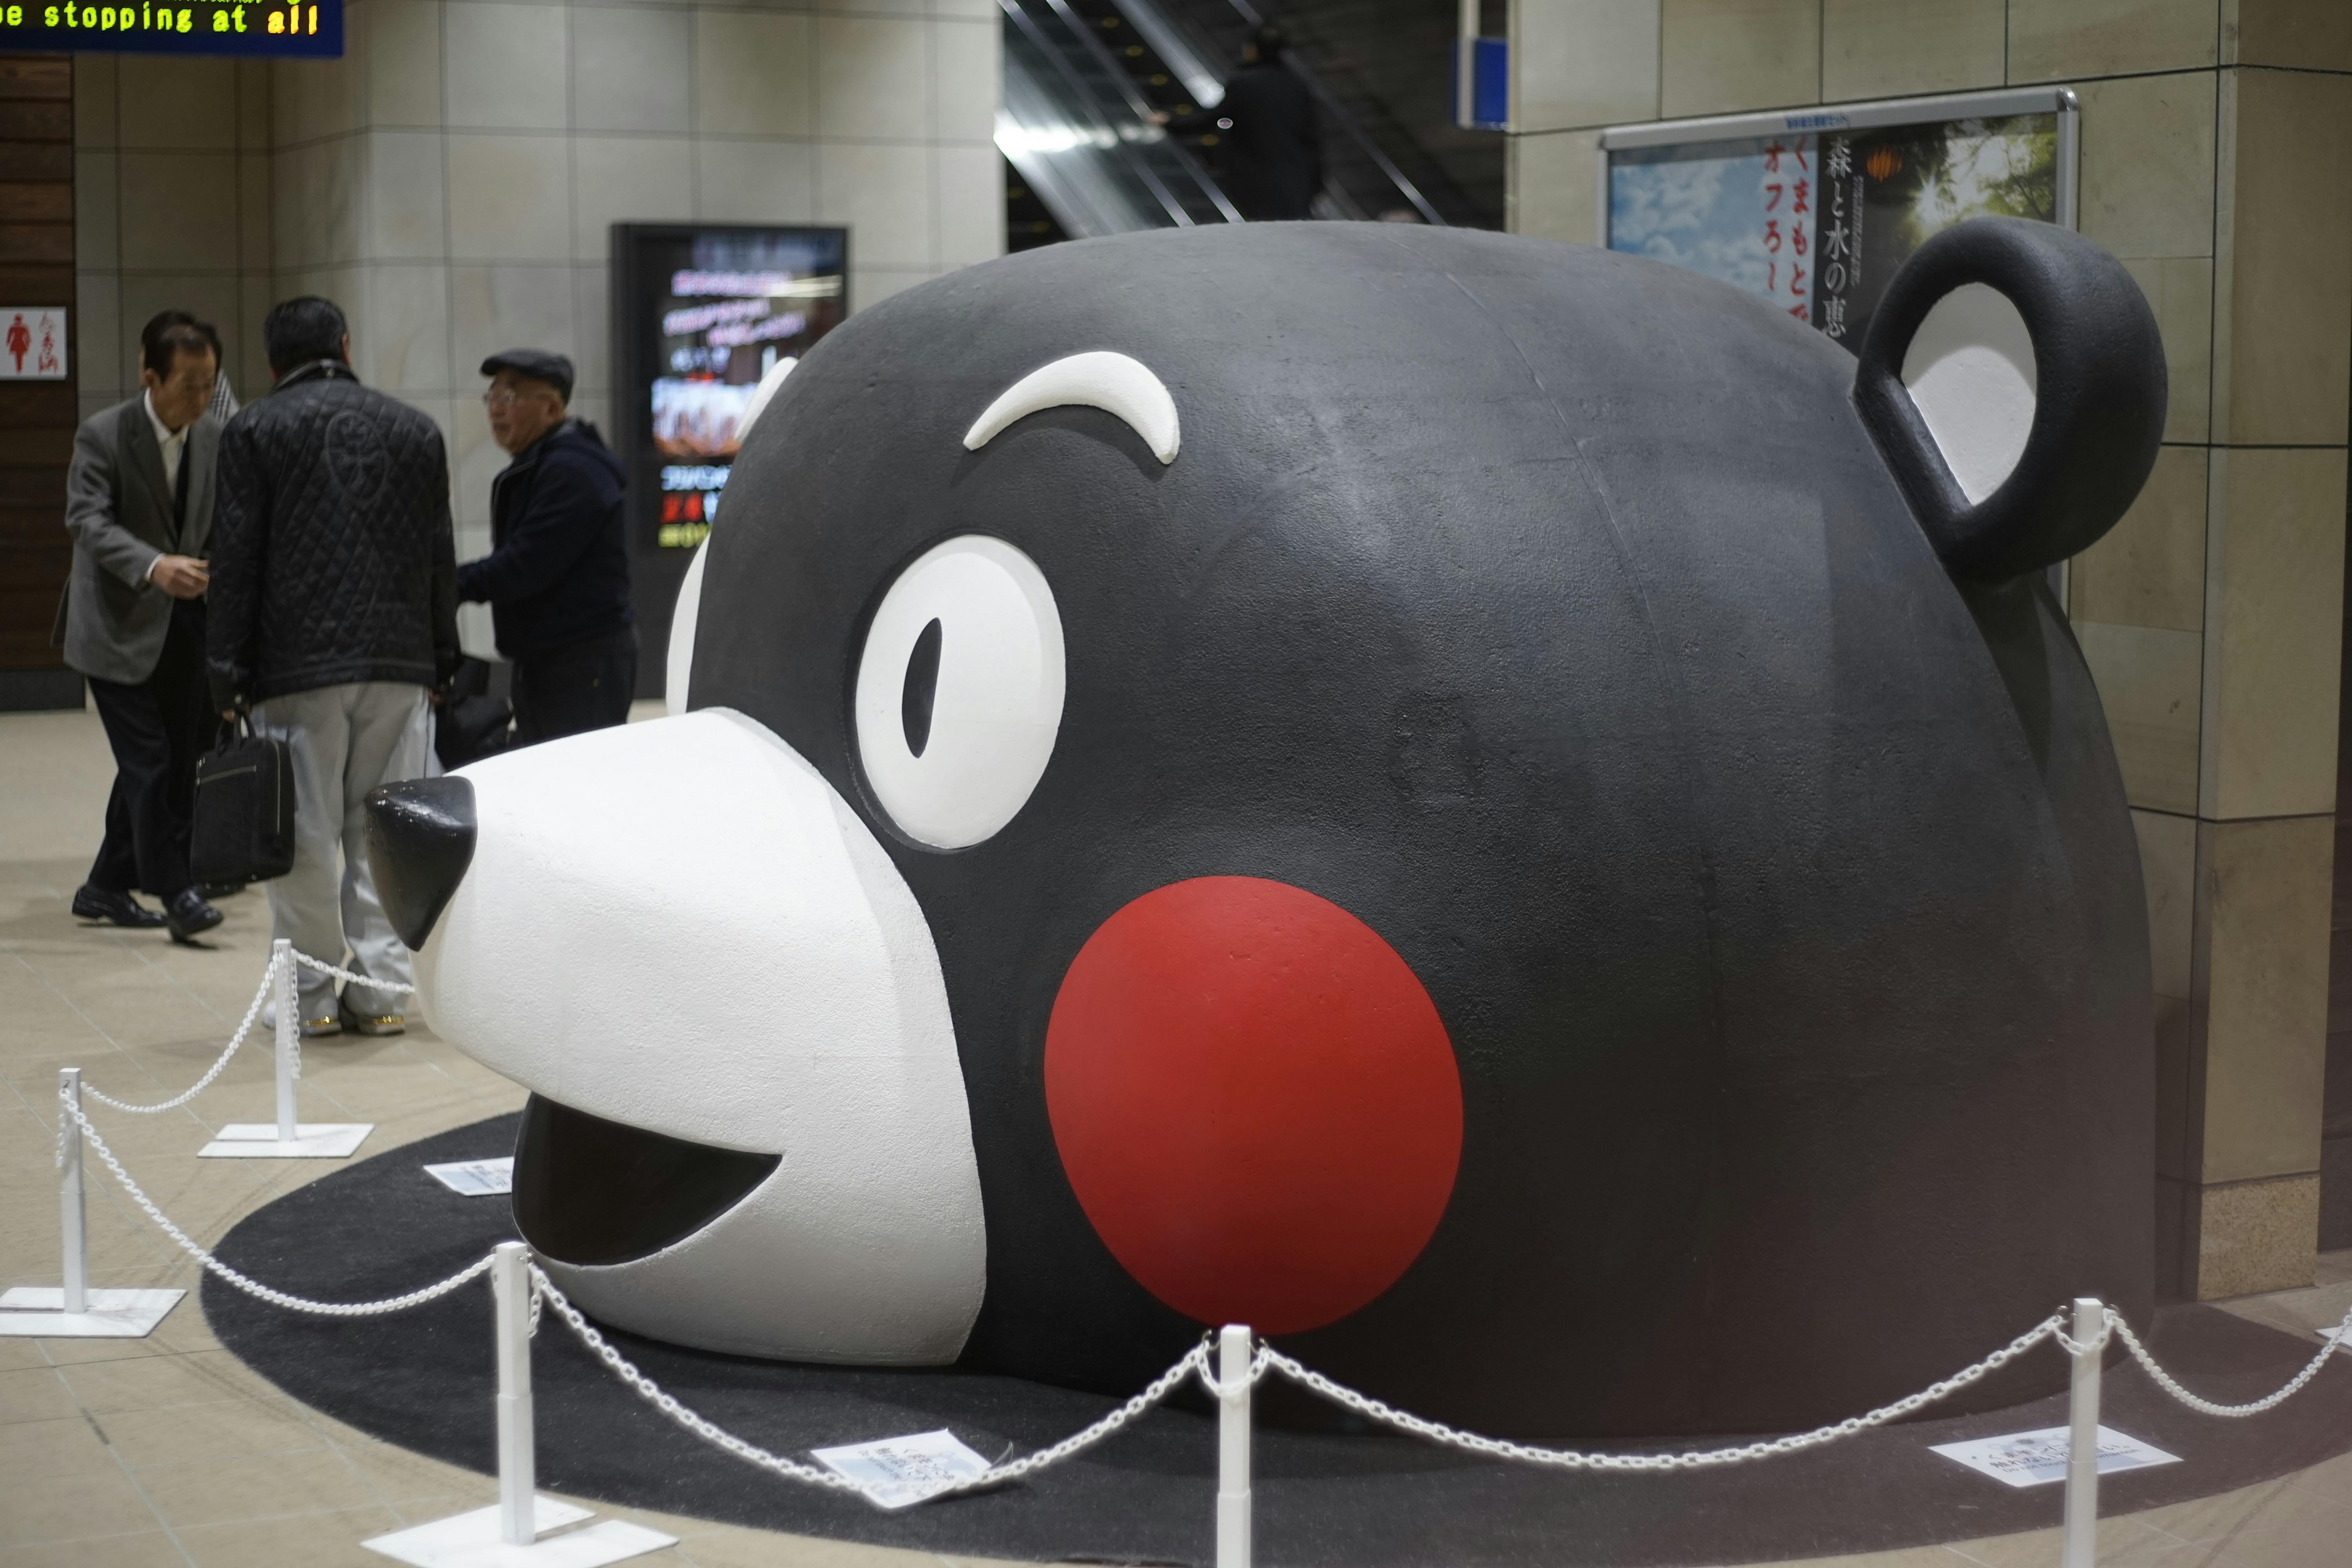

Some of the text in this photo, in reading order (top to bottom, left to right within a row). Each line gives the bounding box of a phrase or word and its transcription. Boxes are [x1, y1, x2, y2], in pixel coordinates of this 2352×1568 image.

[0, 0, 317, 34] e stopping at all
[2096, 1448, 2143, 1458] umamon.
